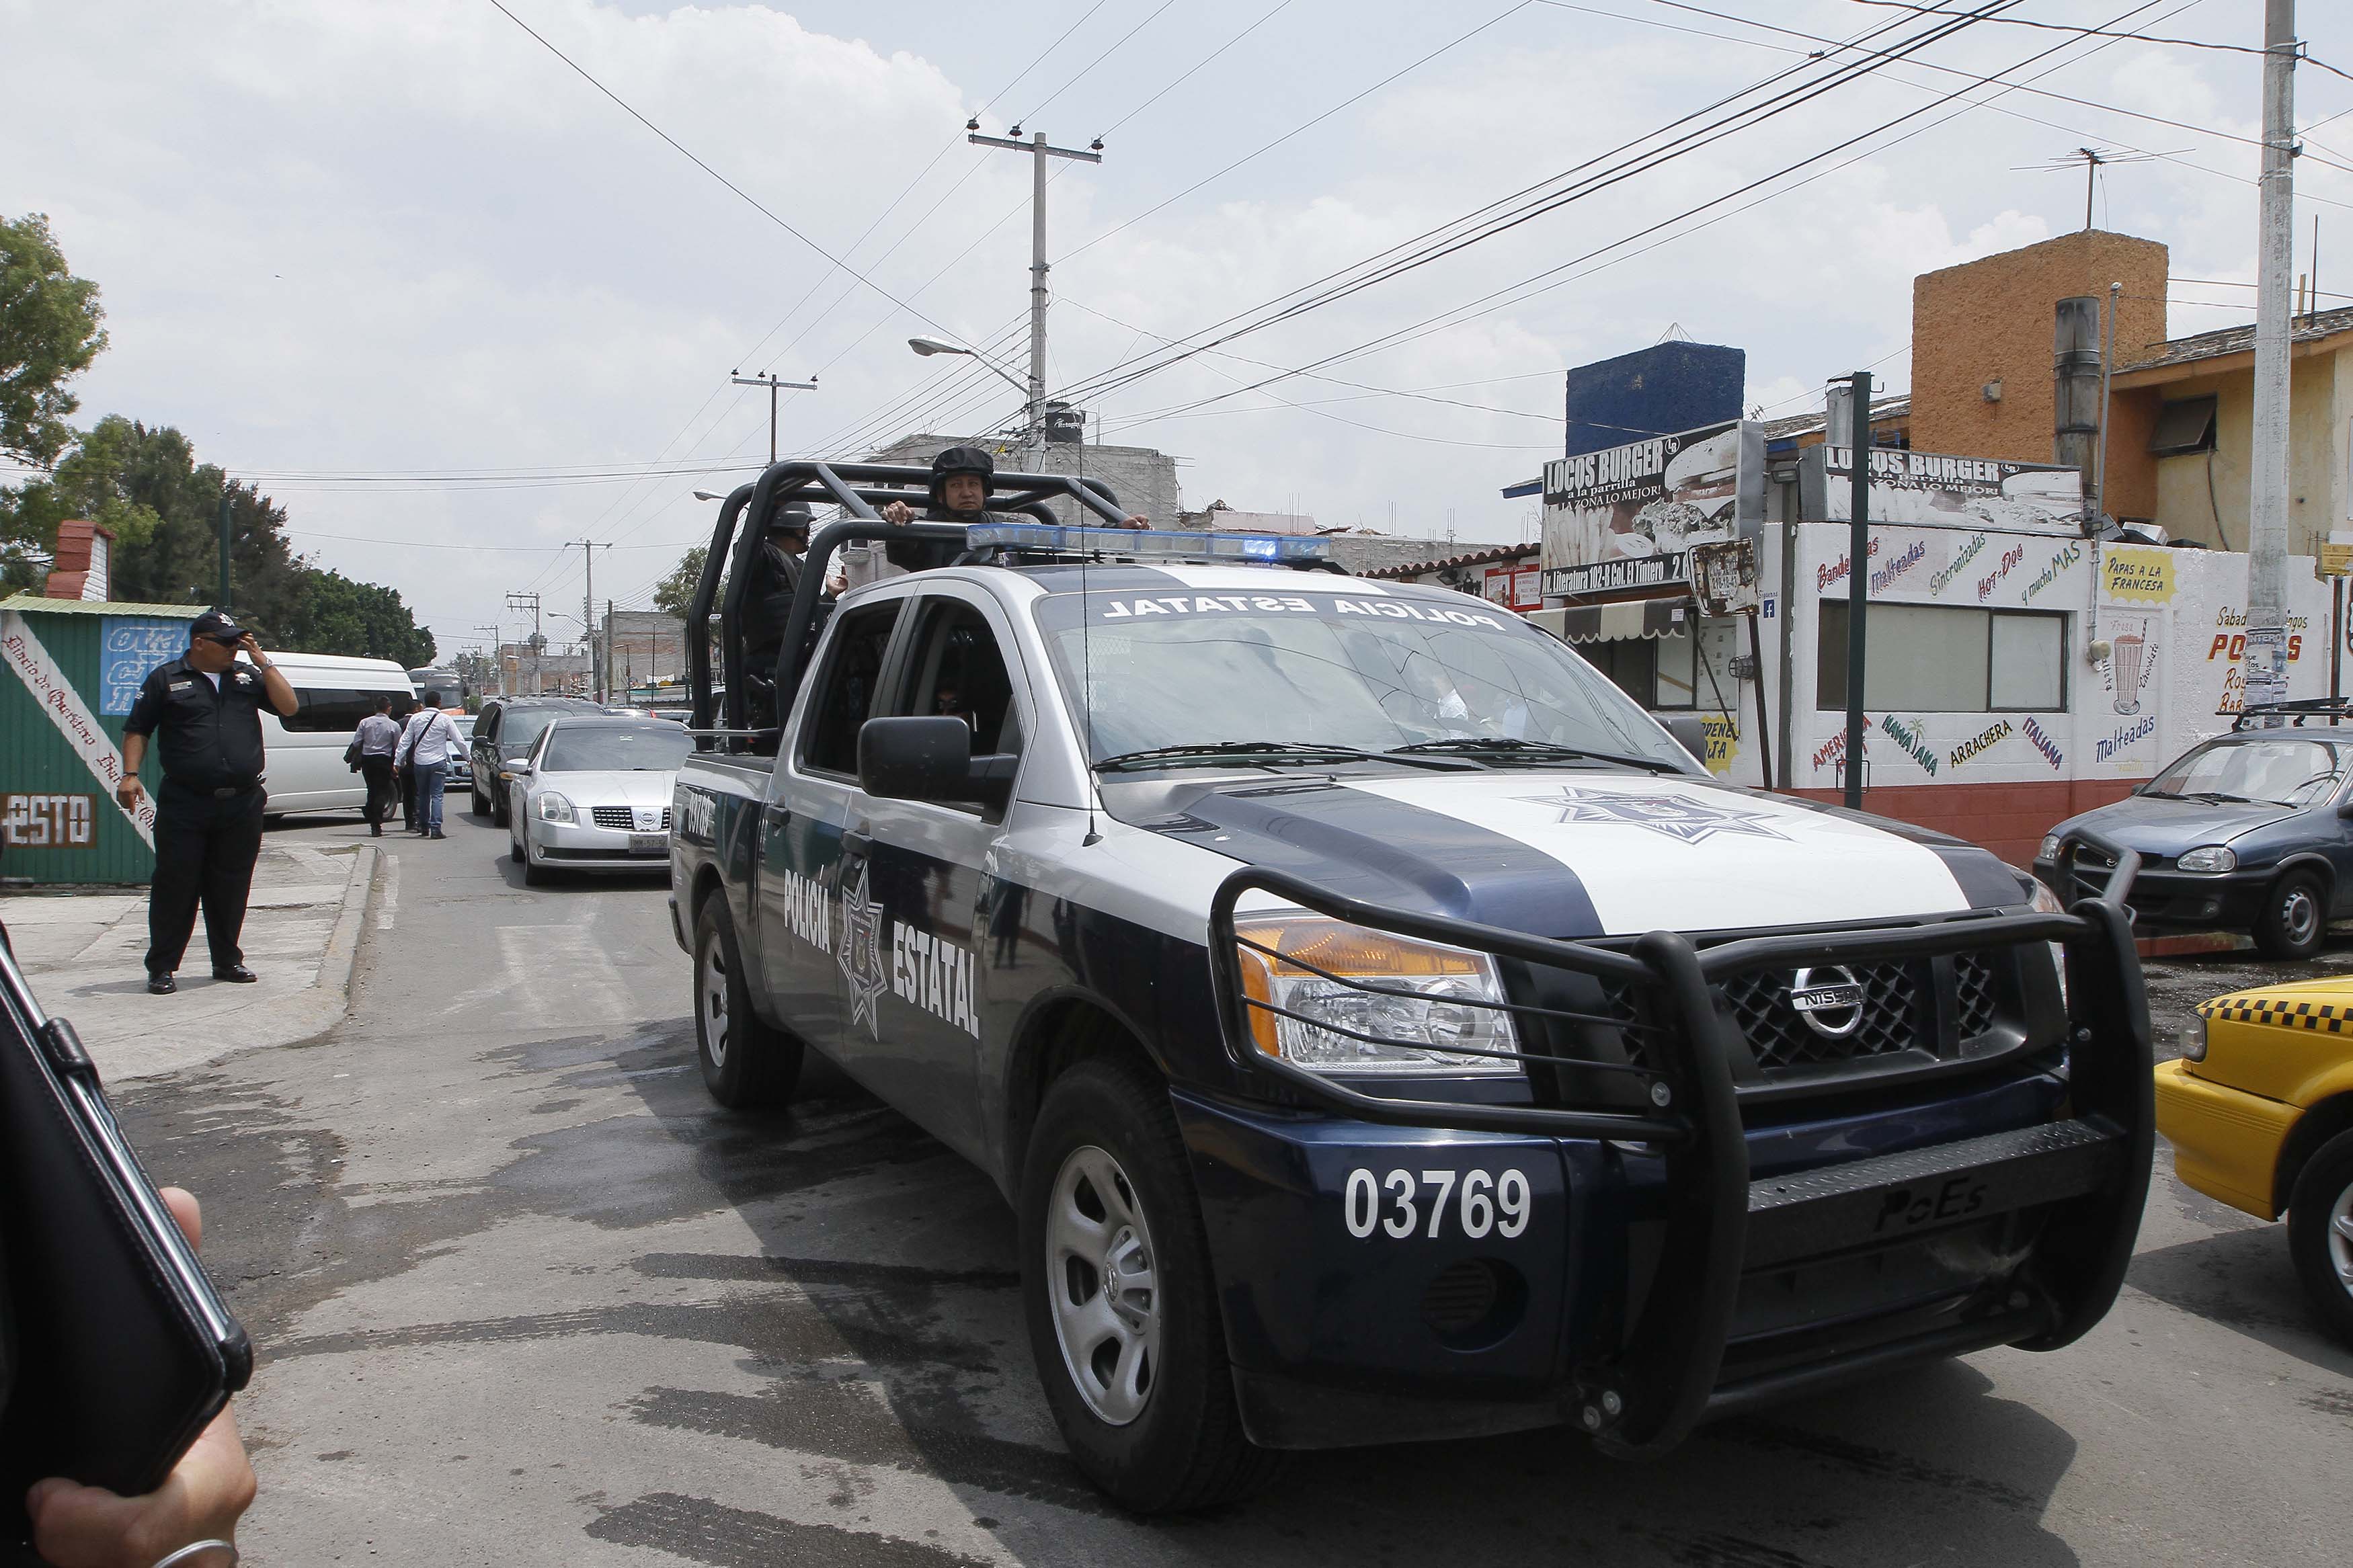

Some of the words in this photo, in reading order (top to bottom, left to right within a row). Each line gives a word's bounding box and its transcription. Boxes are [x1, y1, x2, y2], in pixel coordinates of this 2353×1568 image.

[1547, 455, 1595, 495] LOCOS
[1598, 440, 1663, 485] BURGER
[1825, 446, 1904, 474] LOOS
[1909, 454, 1999, 482] BURGER
[1899, 472, 1964, 484] parrilla
[1574, 497, 1604, 509] ZONA
[1607, 493, 1620, 503] LO
[1622, 485, 1661, 501] MEJOR!
[1591, 477, 1636, 496] parrilla
[1874, 479, 1917, 489] ZONA
[1946, 485, 1998, 495] MEJOR!
[1554, 570, 1588, 592] Literatura
[1611, 563, 1626, 585] Col.
[1627, 561, 1634, 584] El
[1635, 560, 1664, 583] Tintero
[1929, 532, 1986, 597] Sincronizadas
[2029, 567, 2052, 597] mucho
[2051, 540, 2081, 578] MAS
[2108, 556, 2135, 575] PAPAS
[2139, 565, 2145, 575] A
[2148, 565, 2161, 577] LA
[2112, 577, 2163, 591] FRANCESA
[1950, 719, 2013, 769] ARRACHERA
[2021, 716, 2065, 772] ITALIANA
[688, 792, 711, 837] 03769
[783, 864, 831, 954] POLICÍA
[893, 920, 980, 1040] ESTATAL
[1804, 989, 1862, 1006] NISSAN
[1345, 1168, 1531, 1239] 03769
